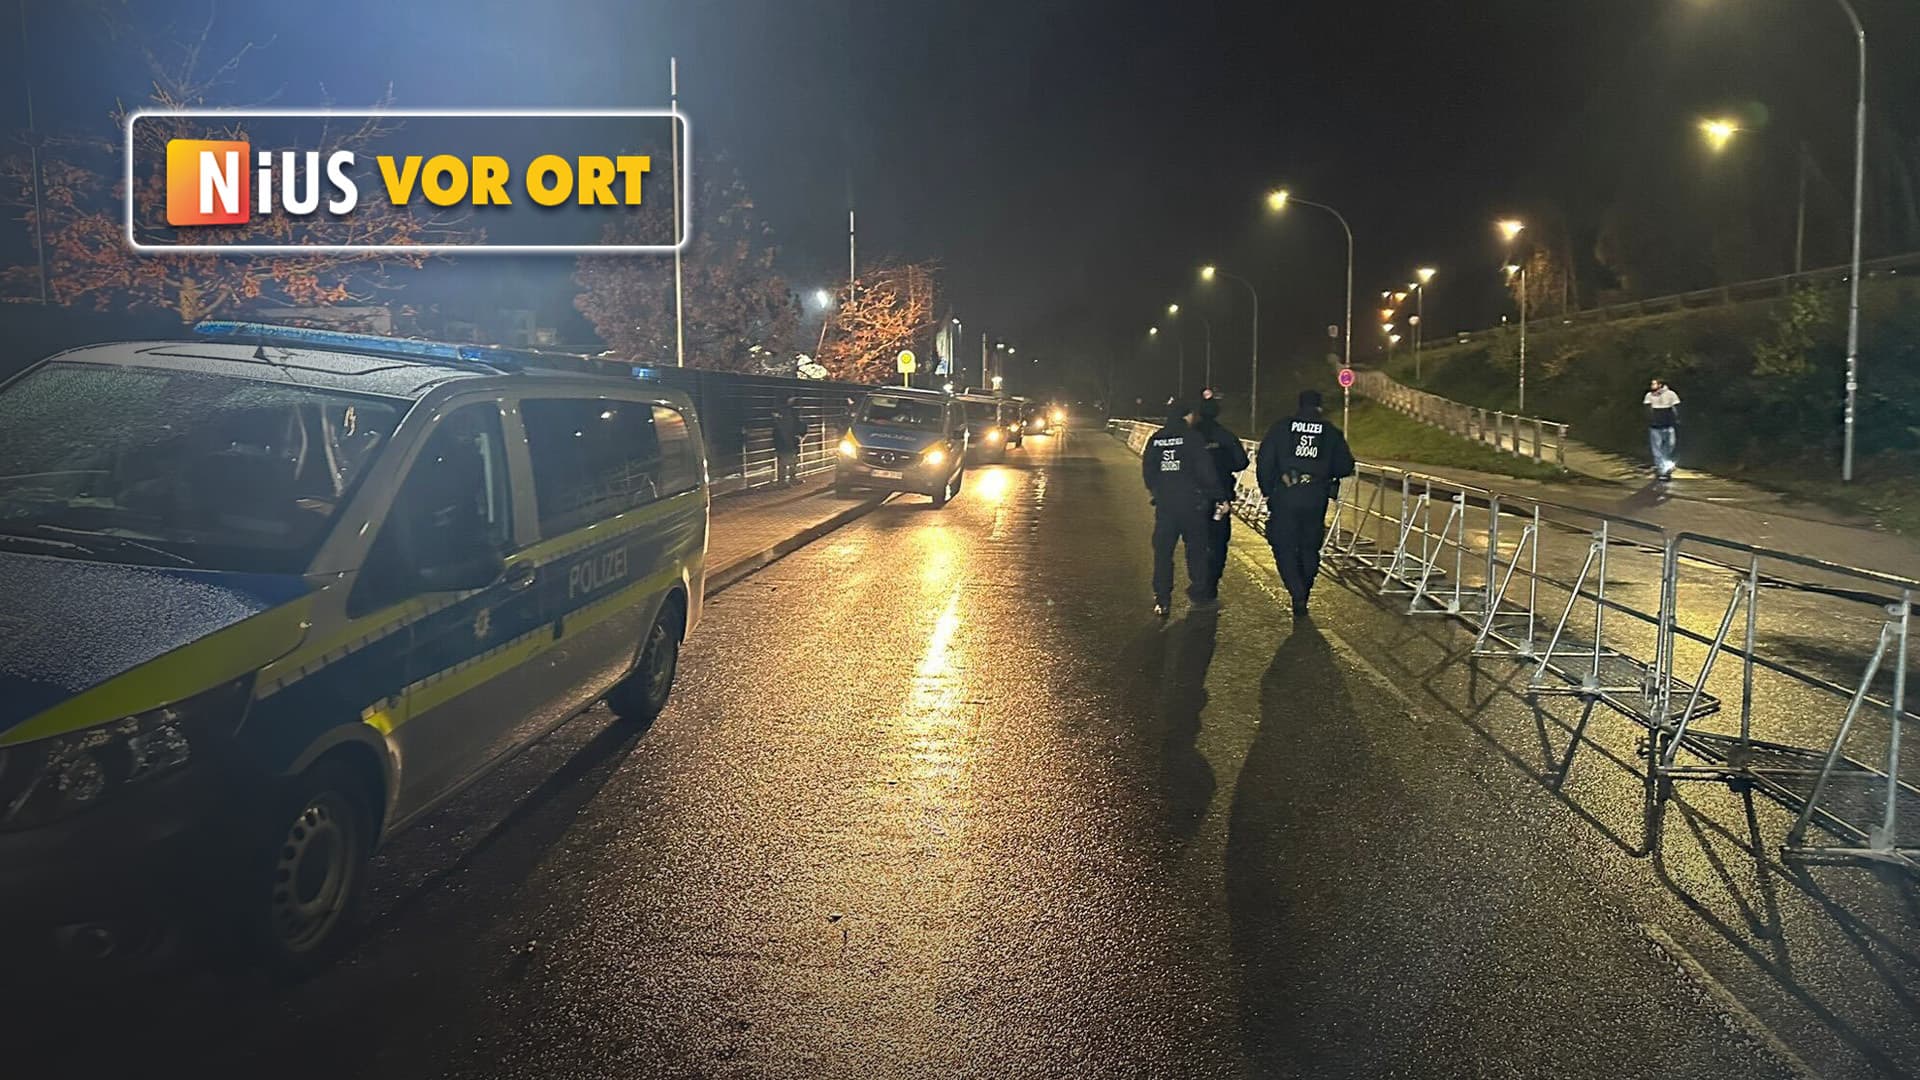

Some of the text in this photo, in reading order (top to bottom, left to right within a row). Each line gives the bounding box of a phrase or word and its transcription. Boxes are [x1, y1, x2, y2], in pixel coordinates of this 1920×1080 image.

[1291, 421, 1323, 434] POLIZEI
[1153, 437, 1184, 447] POLIZEI
[1300, 435, 1315, 446] ST
[1162, 449, 1176, 460] ST
[569, 546, 628, 598] POLIZEI
